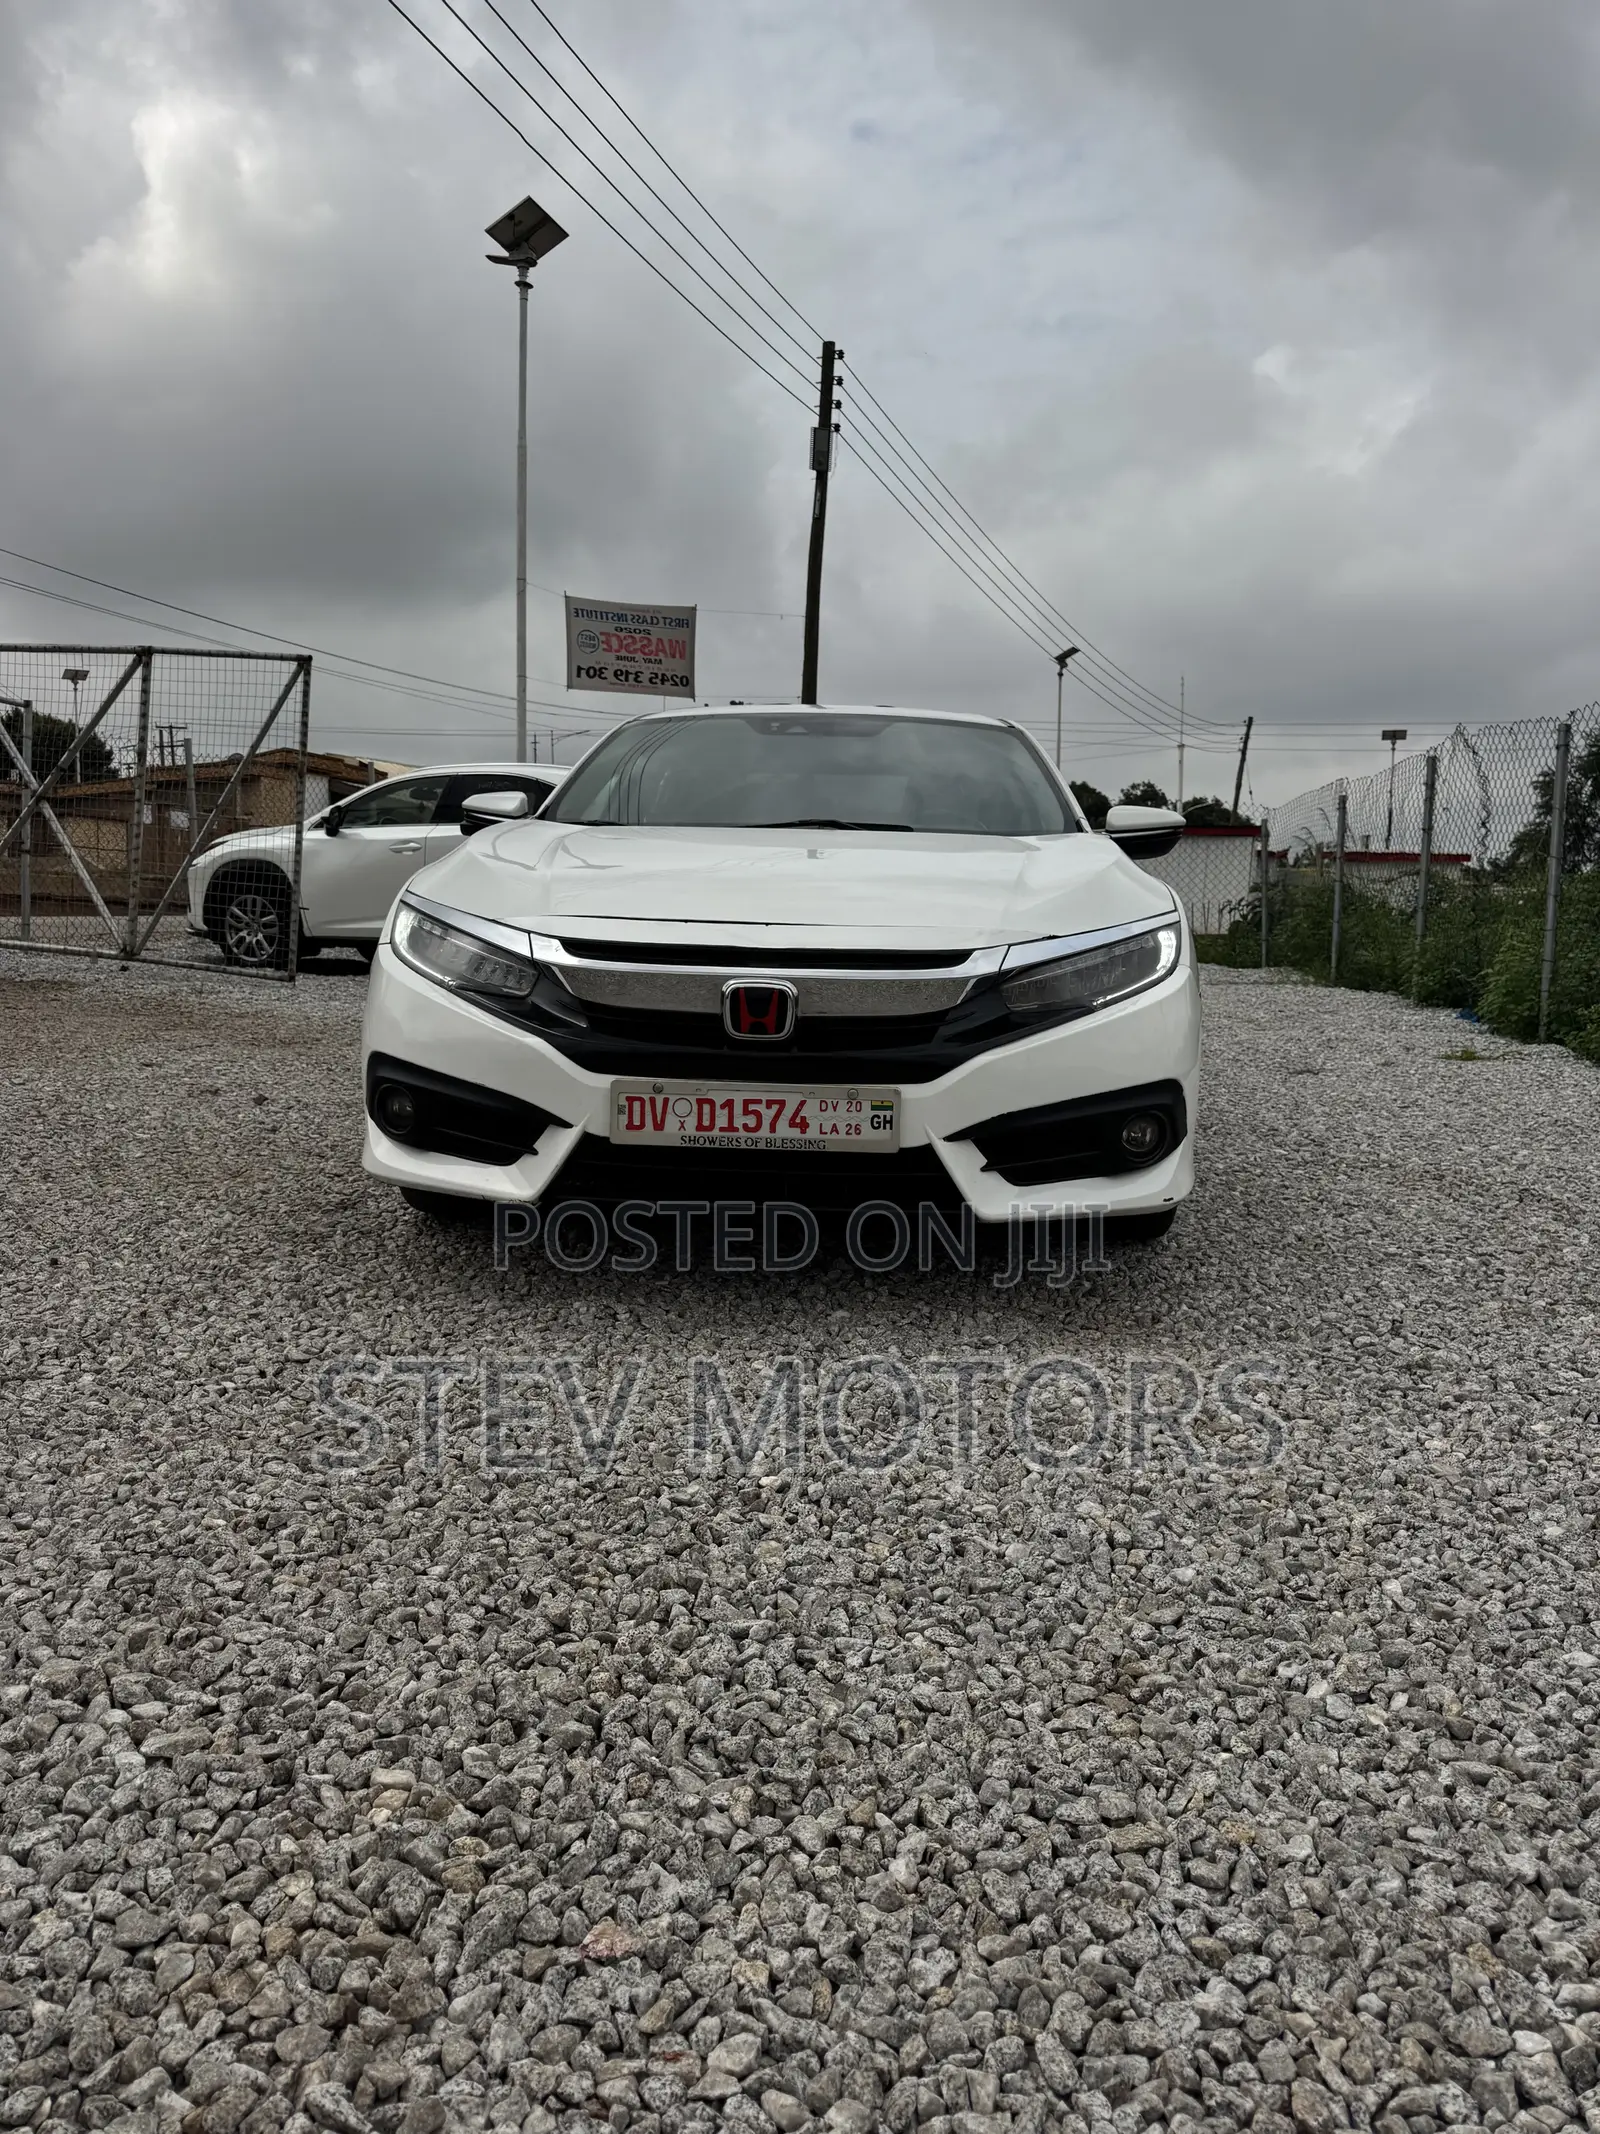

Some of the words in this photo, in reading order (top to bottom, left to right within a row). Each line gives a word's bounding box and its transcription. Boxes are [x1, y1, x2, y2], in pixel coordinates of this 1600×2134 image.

[819, 1100, 839, 1112] DV
[846, 1100, 863, 1112] 20
[625, 1095, 670, 1131] DV
[695, 1098, 810, 1135] D1574
[870, 1114, 893, 1130] GH
[819, 1123, 840, 1135] LA
[845, 1123, 862, 1136] 26
[680, 1135, 742, 1148] SHOWERS
[744, 1137, 763, 1148] OF
[765, 1138, 826, 1150] BLESSING
